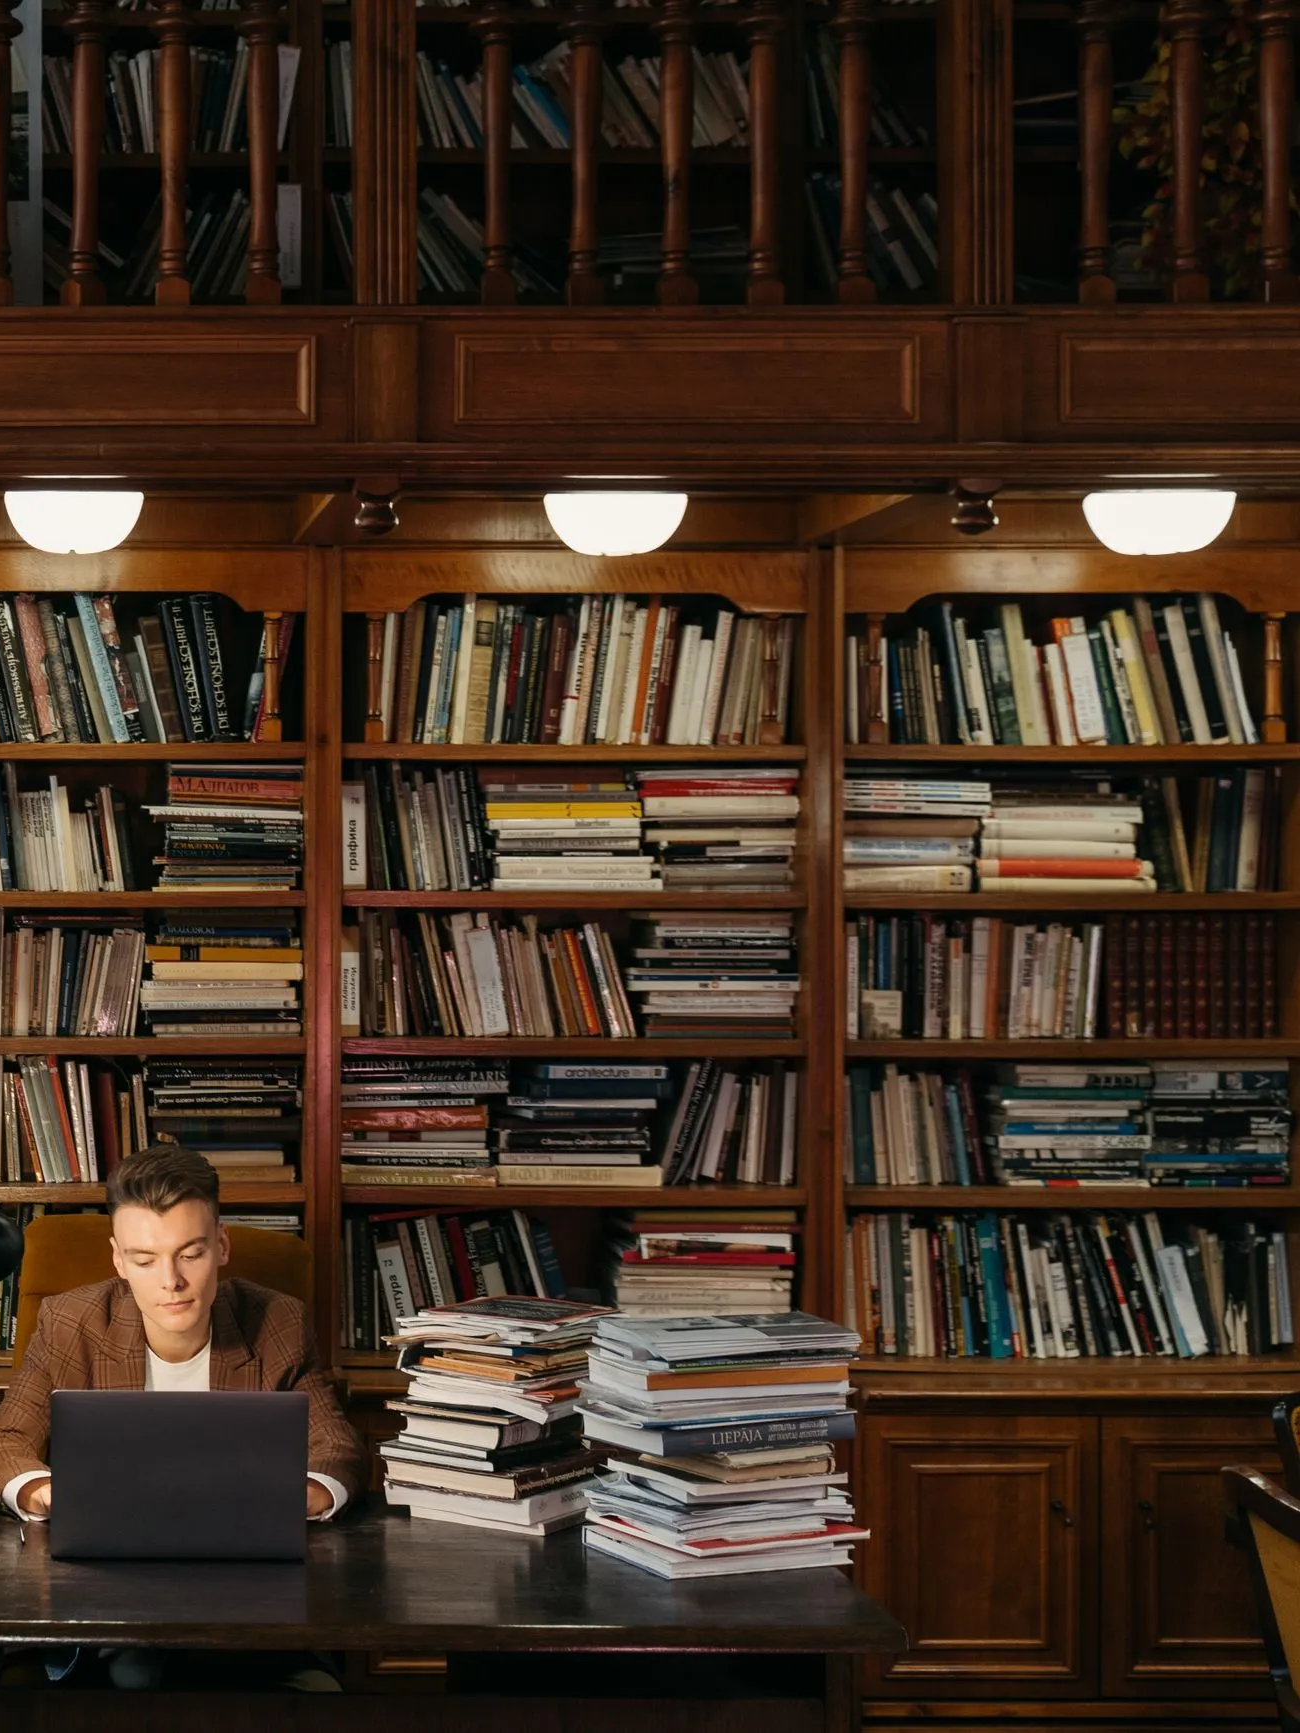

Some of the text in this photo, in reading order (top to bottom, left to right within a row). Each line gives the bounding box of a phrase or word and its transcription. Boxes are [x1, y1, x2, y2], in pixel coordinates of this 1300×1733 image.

[172, 615, 191, 664] SCHRIFT
[201, 606, 220, 657] SCHRIFT
[5, 648, 31, 720] ALTRUSSISCHE
[190, 713, 204, 733] DIE
[217, 709, 229, 729] DIE
[347, 819, 358, 870] графика
[347, 967, 356, 1010] Искусство
[401, 1070, 506, 1082] Splendeurs de PARIS
[565, 1068, 629, 1078] architecture
[689, 1088, 702, 1104] Art
[470, 1260, 480, 1273] de
[472, 1273, 486, 1295] Rois
[386, 1273, 407, 1317] ьптура
[710, 1426, 763, 1446] LIEPĀJA
